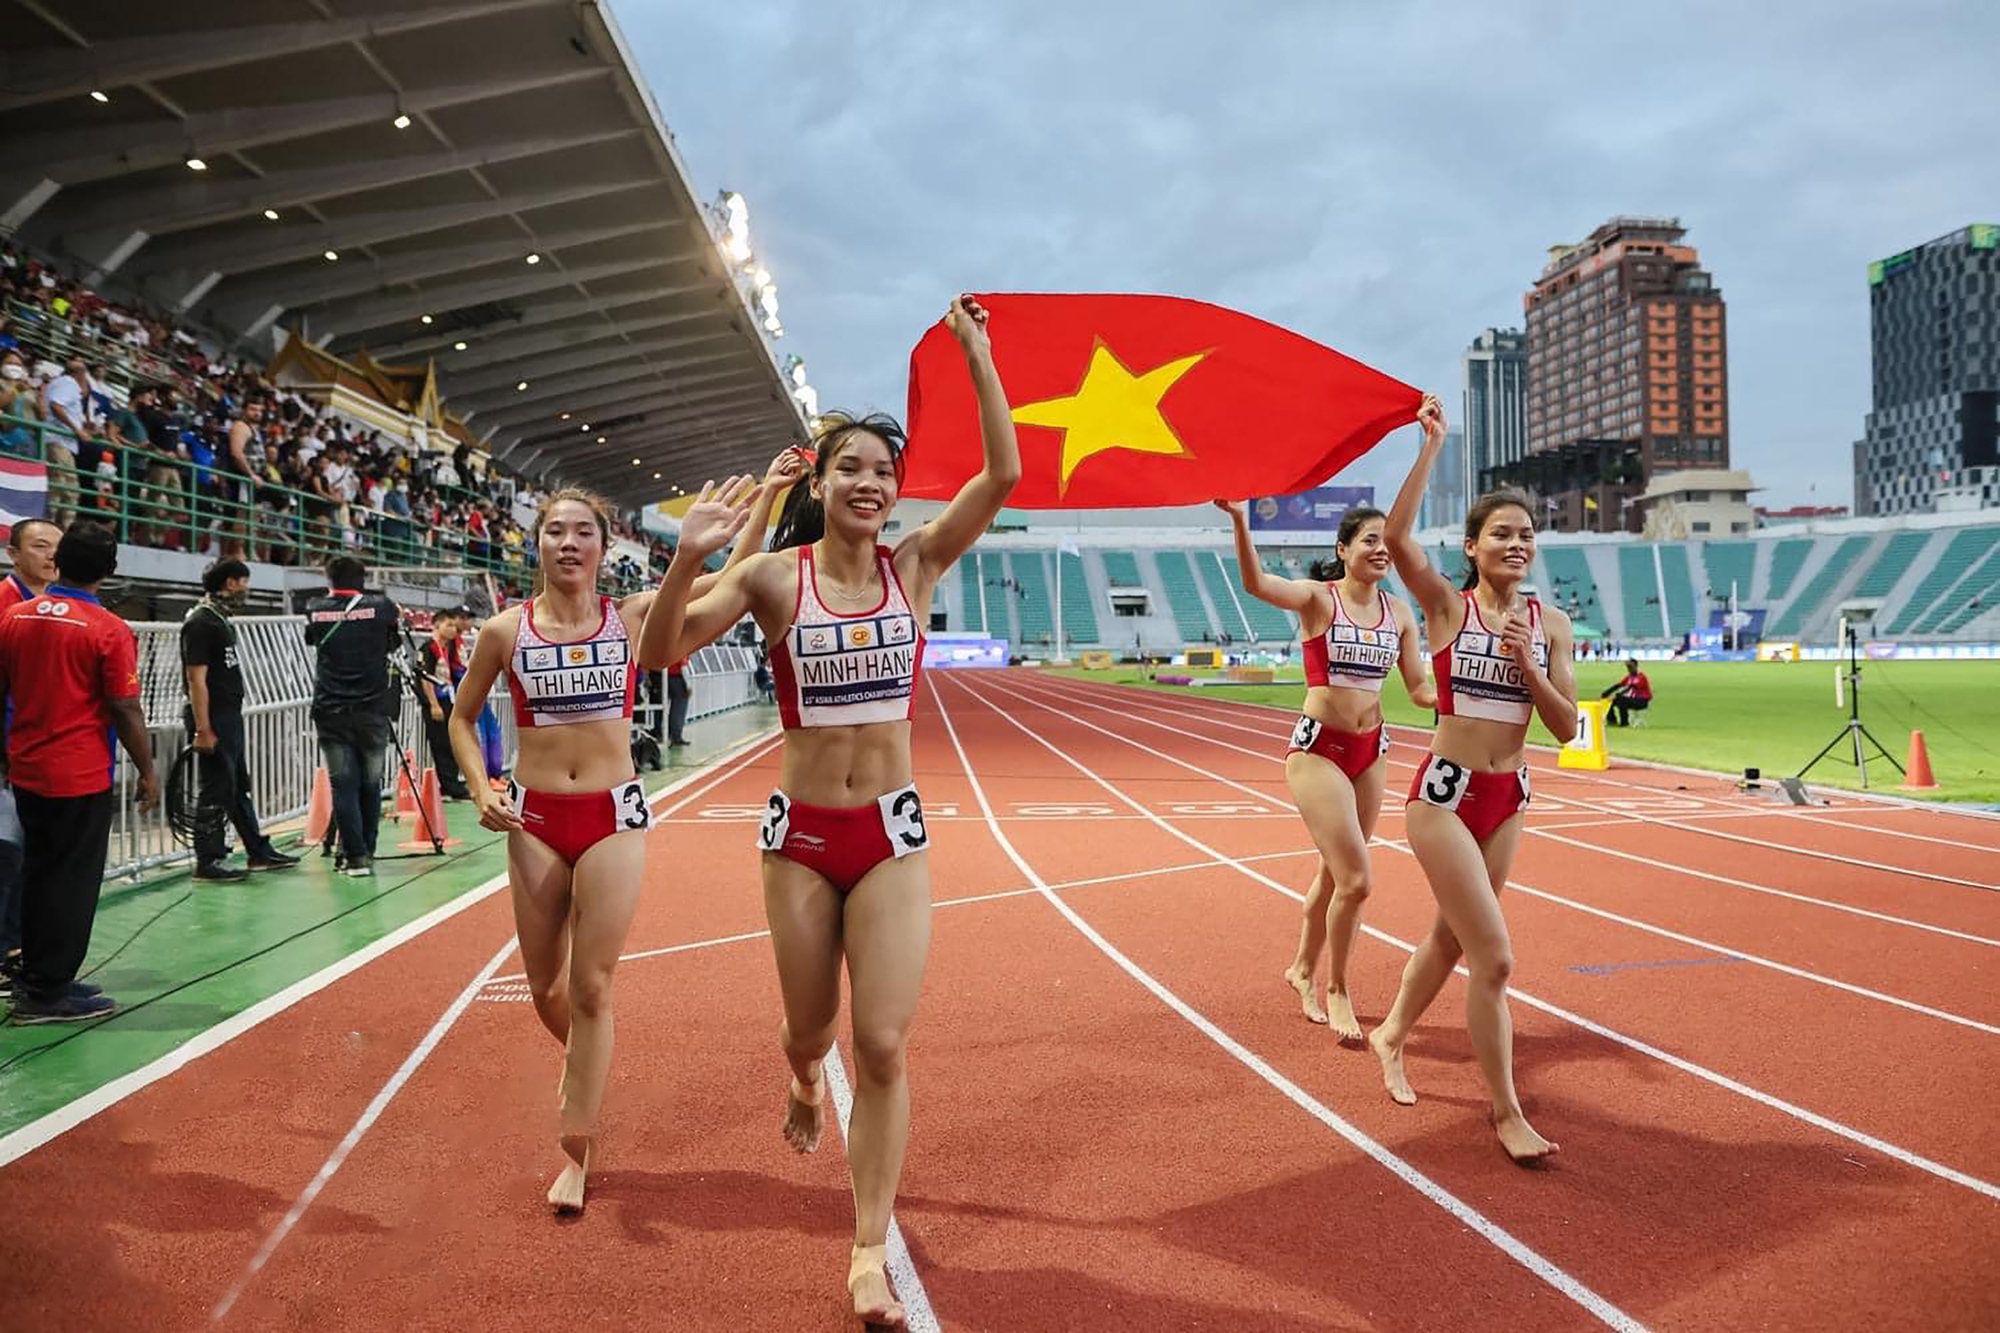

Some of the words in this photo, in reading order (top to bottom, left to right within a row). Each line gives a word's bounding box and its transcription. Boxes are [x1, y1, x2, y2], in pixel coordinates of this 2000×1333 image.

[1335, 645, 1356, 661] THI
[803, 656, 859, 684] MINH
[1457, 656, 1487, 679] THI
[531, 673, 564, 696] THI
[571, 669, 623, 694] HANG
[1578, 716, 1585, 739] 1
[1426, 758, 1462, 804] 3
[623, 784, 648, 829] 3
[893, 790, 927, 848] 3
[763, 794, 786, 848] 3
